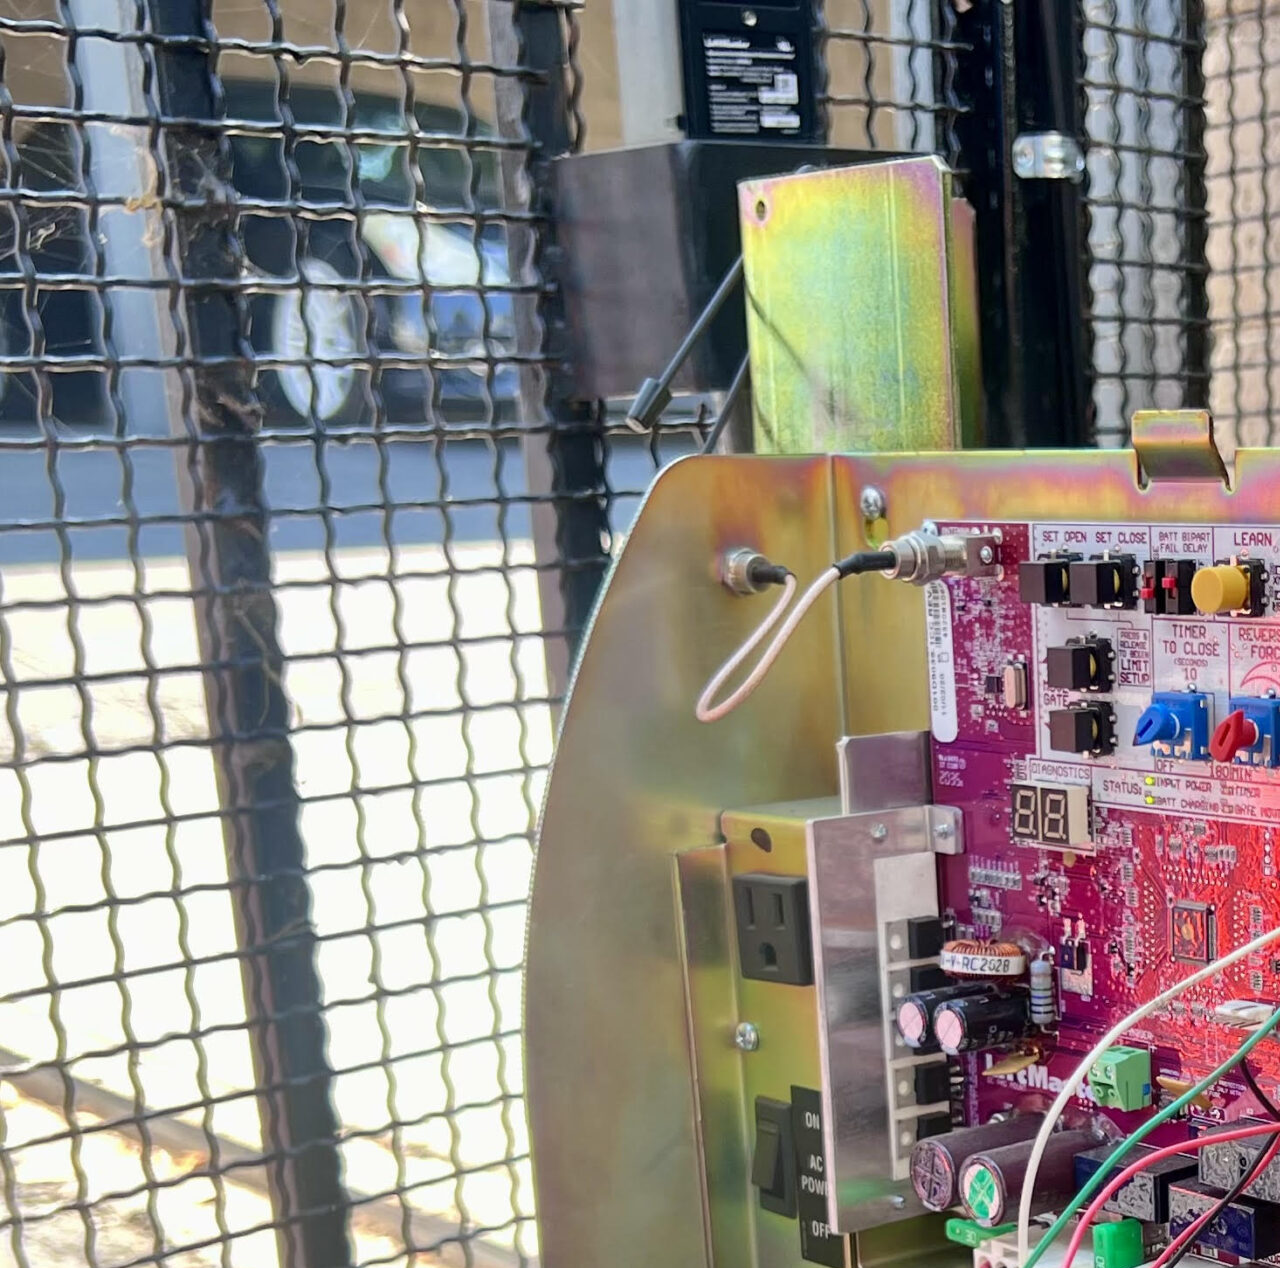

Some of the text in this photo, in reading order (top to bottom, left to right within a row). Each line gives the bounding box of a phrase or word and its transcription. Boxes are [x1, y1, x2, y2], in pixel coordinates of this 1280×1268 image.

[1043, 531, 1147, 544] SET OPEN SET CLOSE
[1158, 531, 1177, 541] BATT
[1233, 532, 1272, 546] LEARN
[1160, 543, 1208, 553] FAIL DELAY
[1171, 623, 1207, 638] TIMER
[1163, 640, 1220, 657] TO CLOSE
[1121, 660, 1149, 671] LIMIT
[1120, 673, 1150, 684] SETUP
[1183, 668, 1198, 680] 10
[1043, 693, 1069, 707] GATE
[1031, 762, 1091, 780] DIAGNOSTICS
[1156, 759, 1175, 772] OFF
[1231, 765, 1252, 782] MIN
[1103, 779, 1142, 796] STATUS:
[1186, 780, 1212, 791] POWER
[804, 1111, 821, 1131] ON
[809, 1154, 824, 1172] AC
